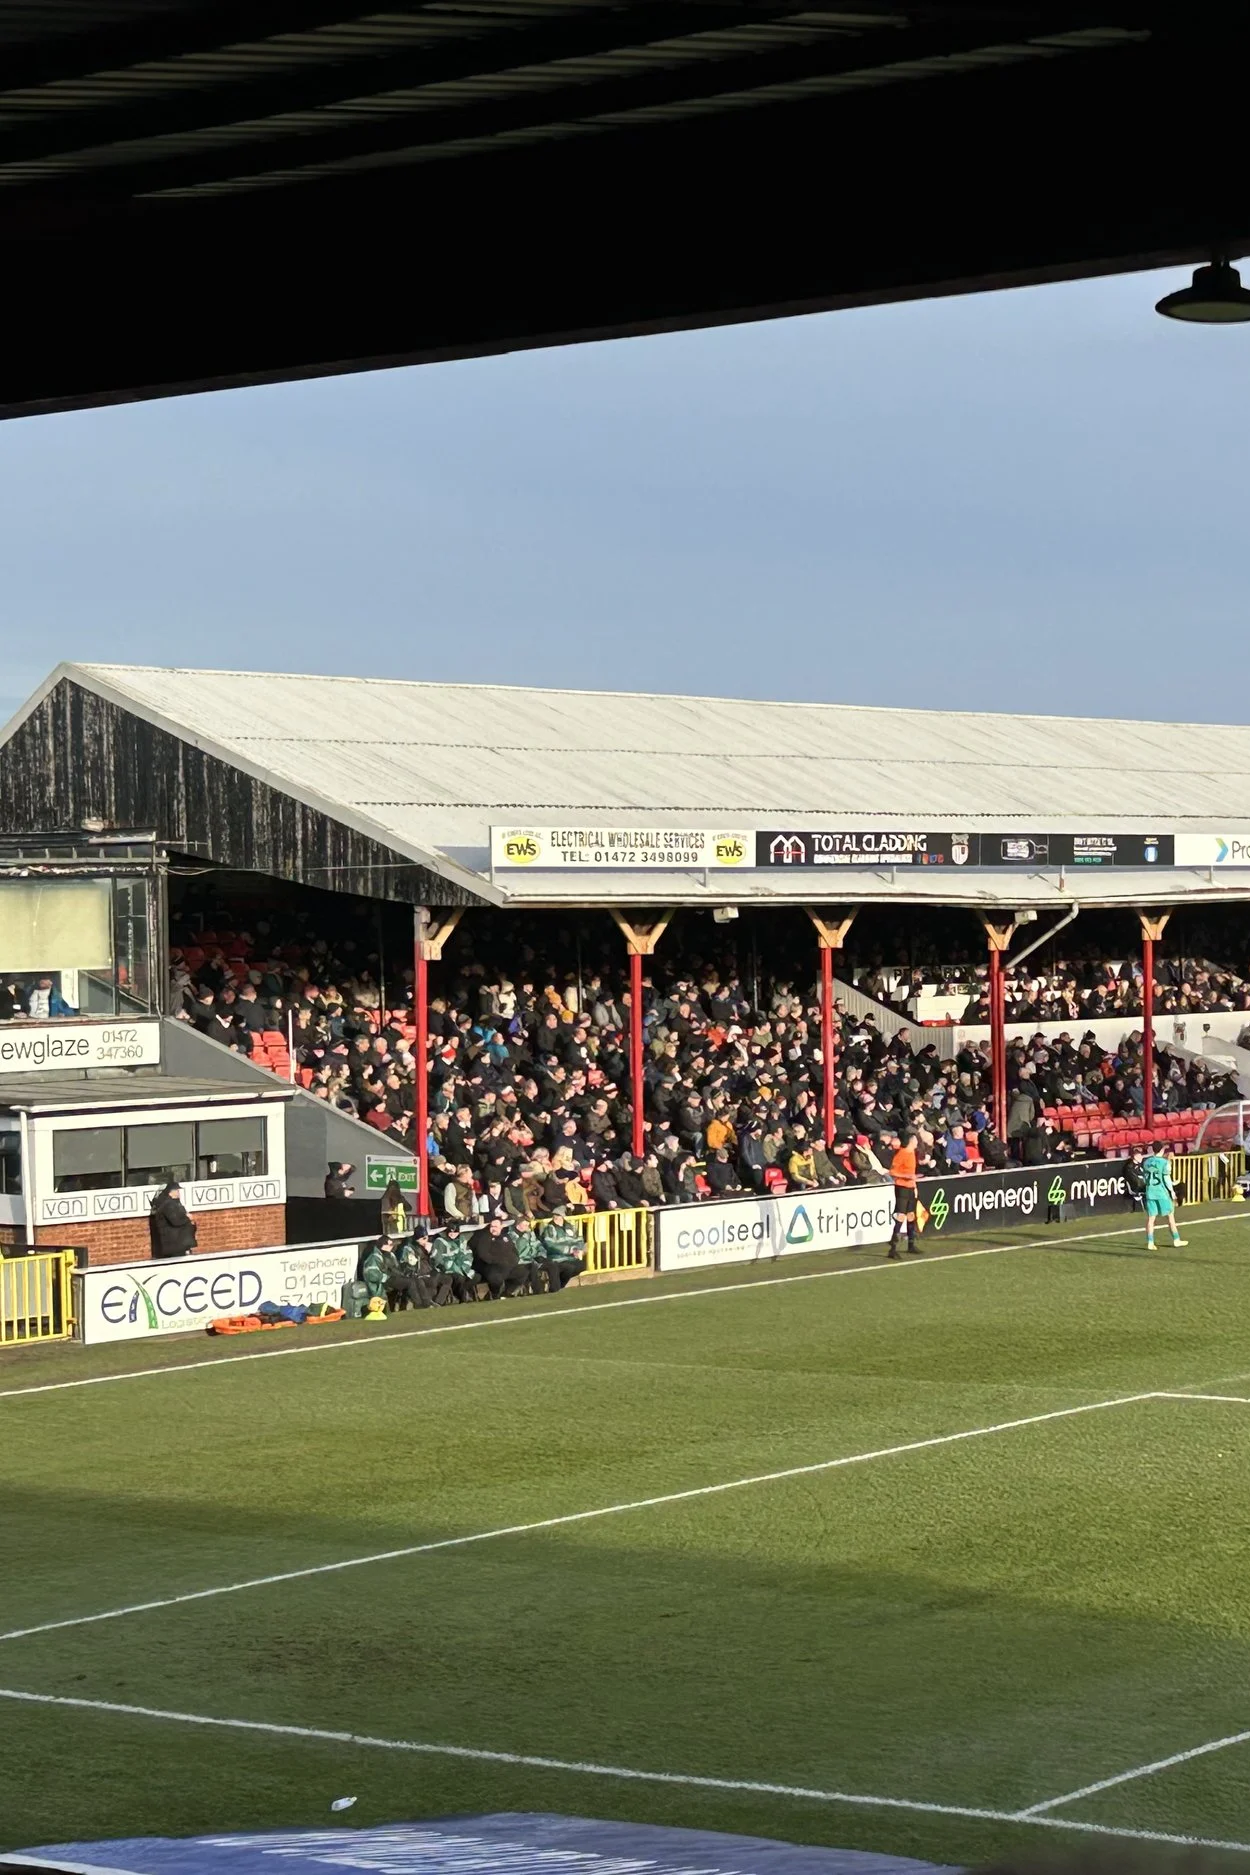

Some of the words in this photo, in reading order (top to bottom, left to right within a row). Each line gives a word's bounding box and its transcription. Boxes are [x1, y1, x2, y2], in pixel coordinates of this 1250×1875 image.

[506, 838, 537, 856] EWS
[551, 831, 605, 848] ELECTRICAL
[608, 831, 660, 849] WHOLESALE
[663, 832, 705, 849] SERVICES
[716, 840, 743, 857] EWS
[811, 834, 860, 851] TOTAL
[862, 834, 927, 851] CLADDING
[594, 851, 636, 862] 01472
[641, 851, 698, 863] 3498099
[1, 1034, 89, 1064] ewglaze
[97, 1045, 143, 1060] 347360
[46, 1201, 83, 1217] van
[97, 1195, 133, 1212] van
[194, 1186, 230, 1202] van
[242, 1182, 277, 1198] van
[953, 1180, 1038, 1220] myenergi
[1070, 1176, 1125, 1207] myene
[677, 1214, 770, 1250] coolseal
[285, 1270, 346, 1290] 01469
[101, 1270, 262, 1329] EXCEED
